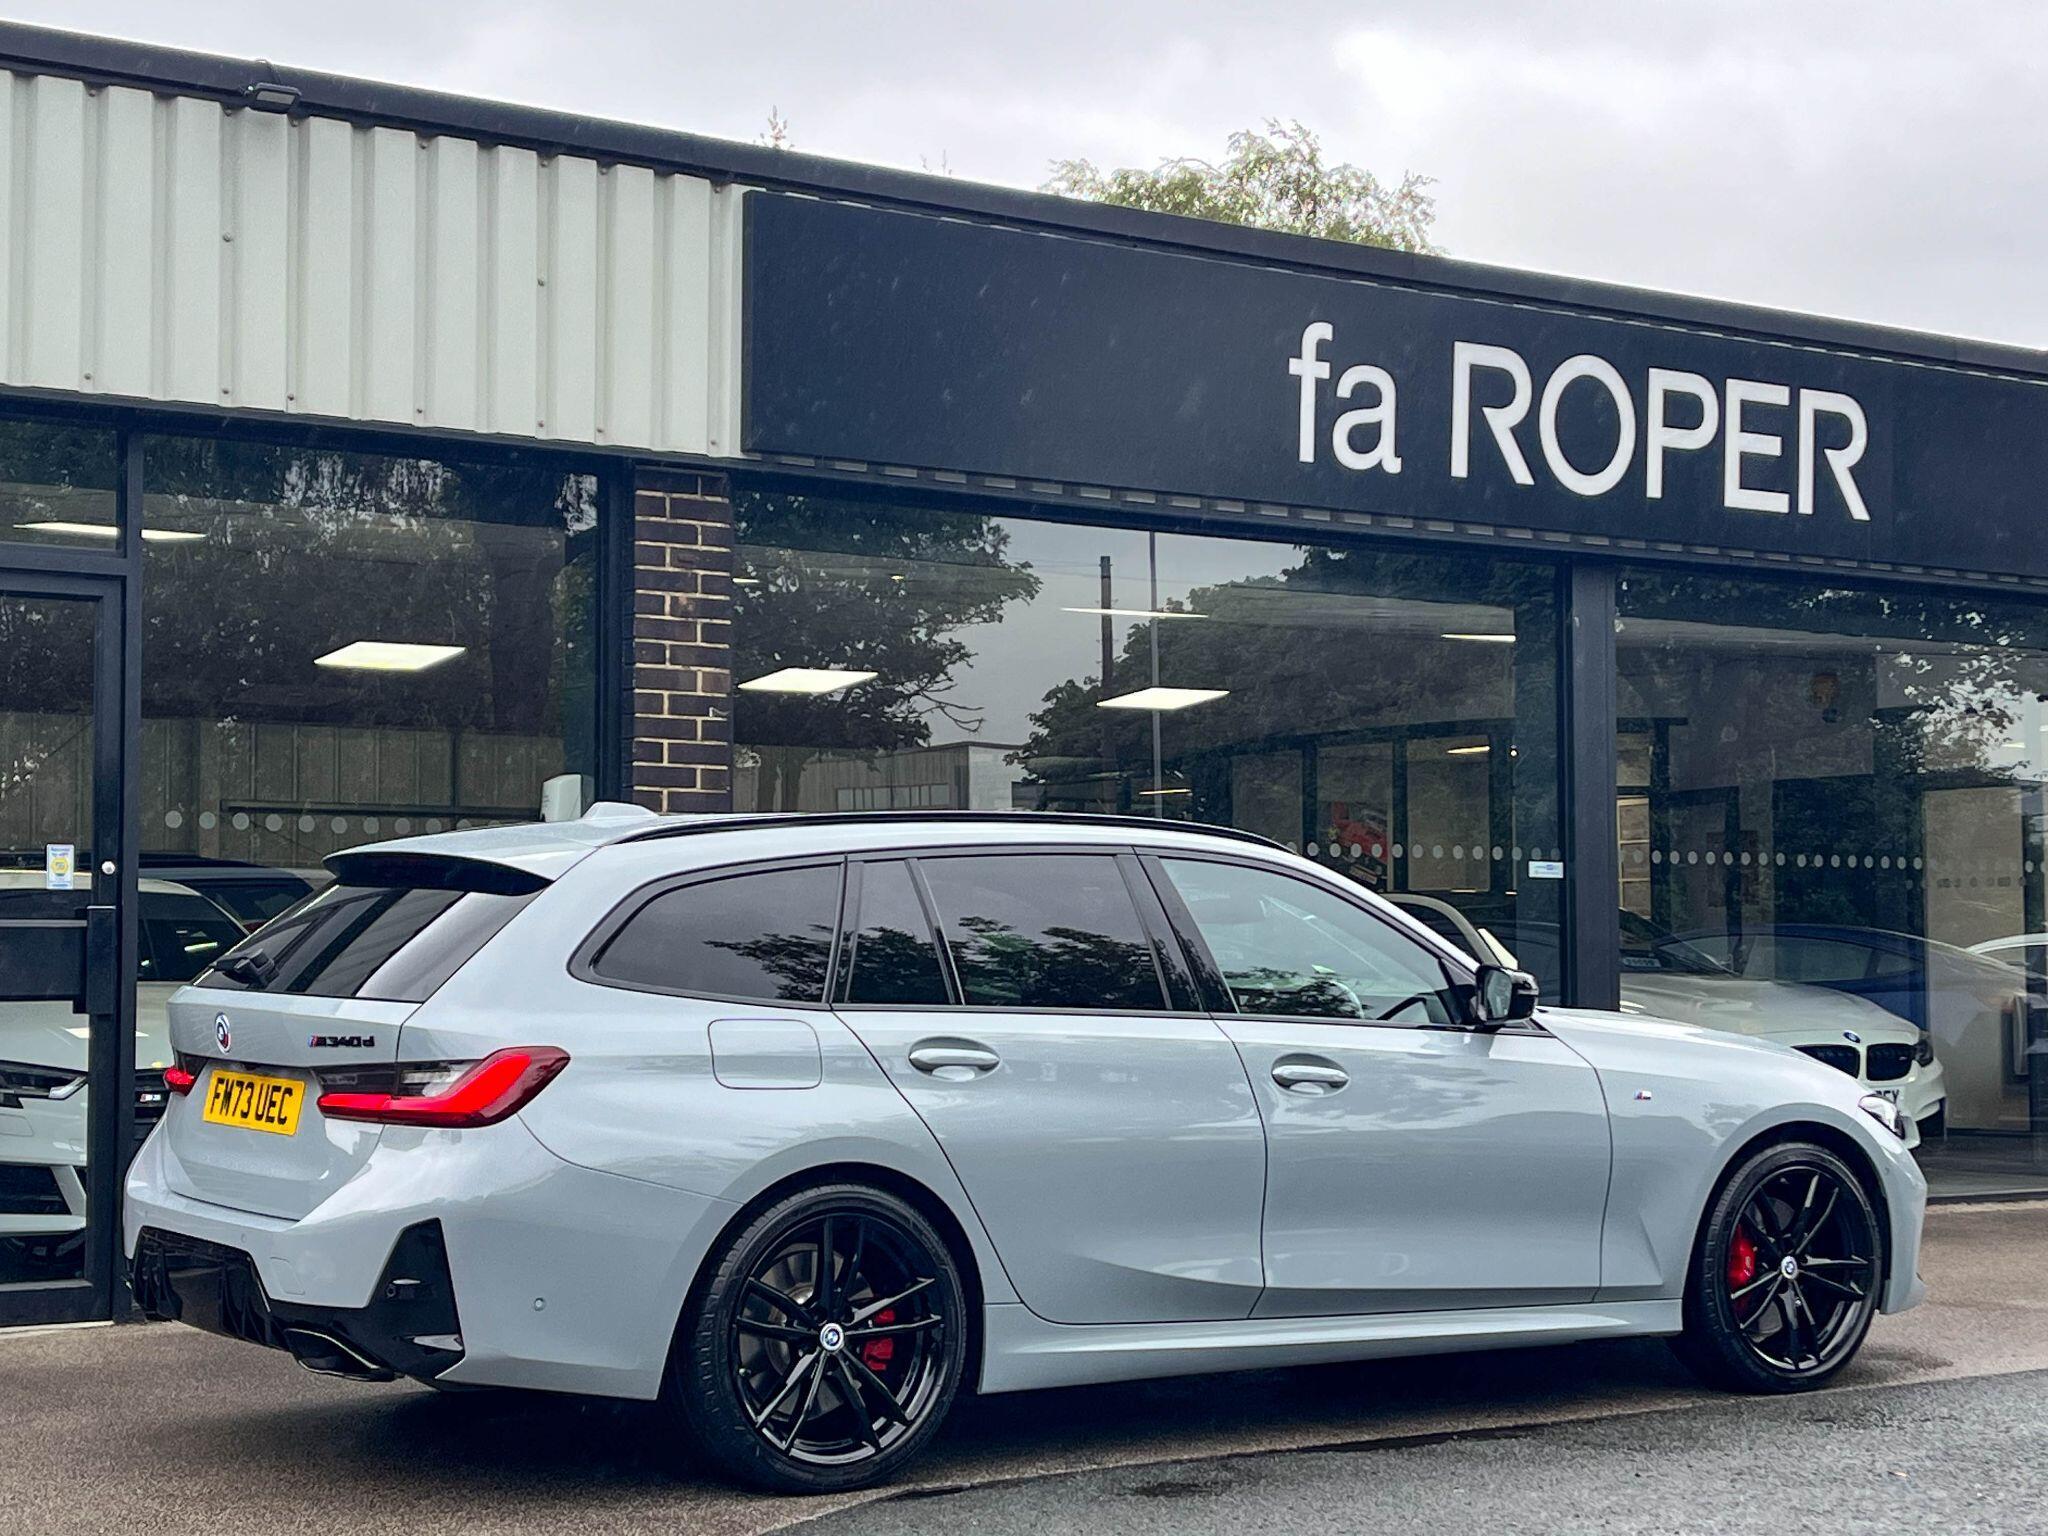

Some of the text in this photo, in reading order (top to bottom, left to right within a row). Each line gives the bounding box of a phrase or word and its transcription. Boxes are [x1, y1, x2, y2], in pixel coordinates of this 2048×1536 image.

[1288, 321, 1871, 521] fa ROPER
[254, 1083, 293, 1125] UEC
